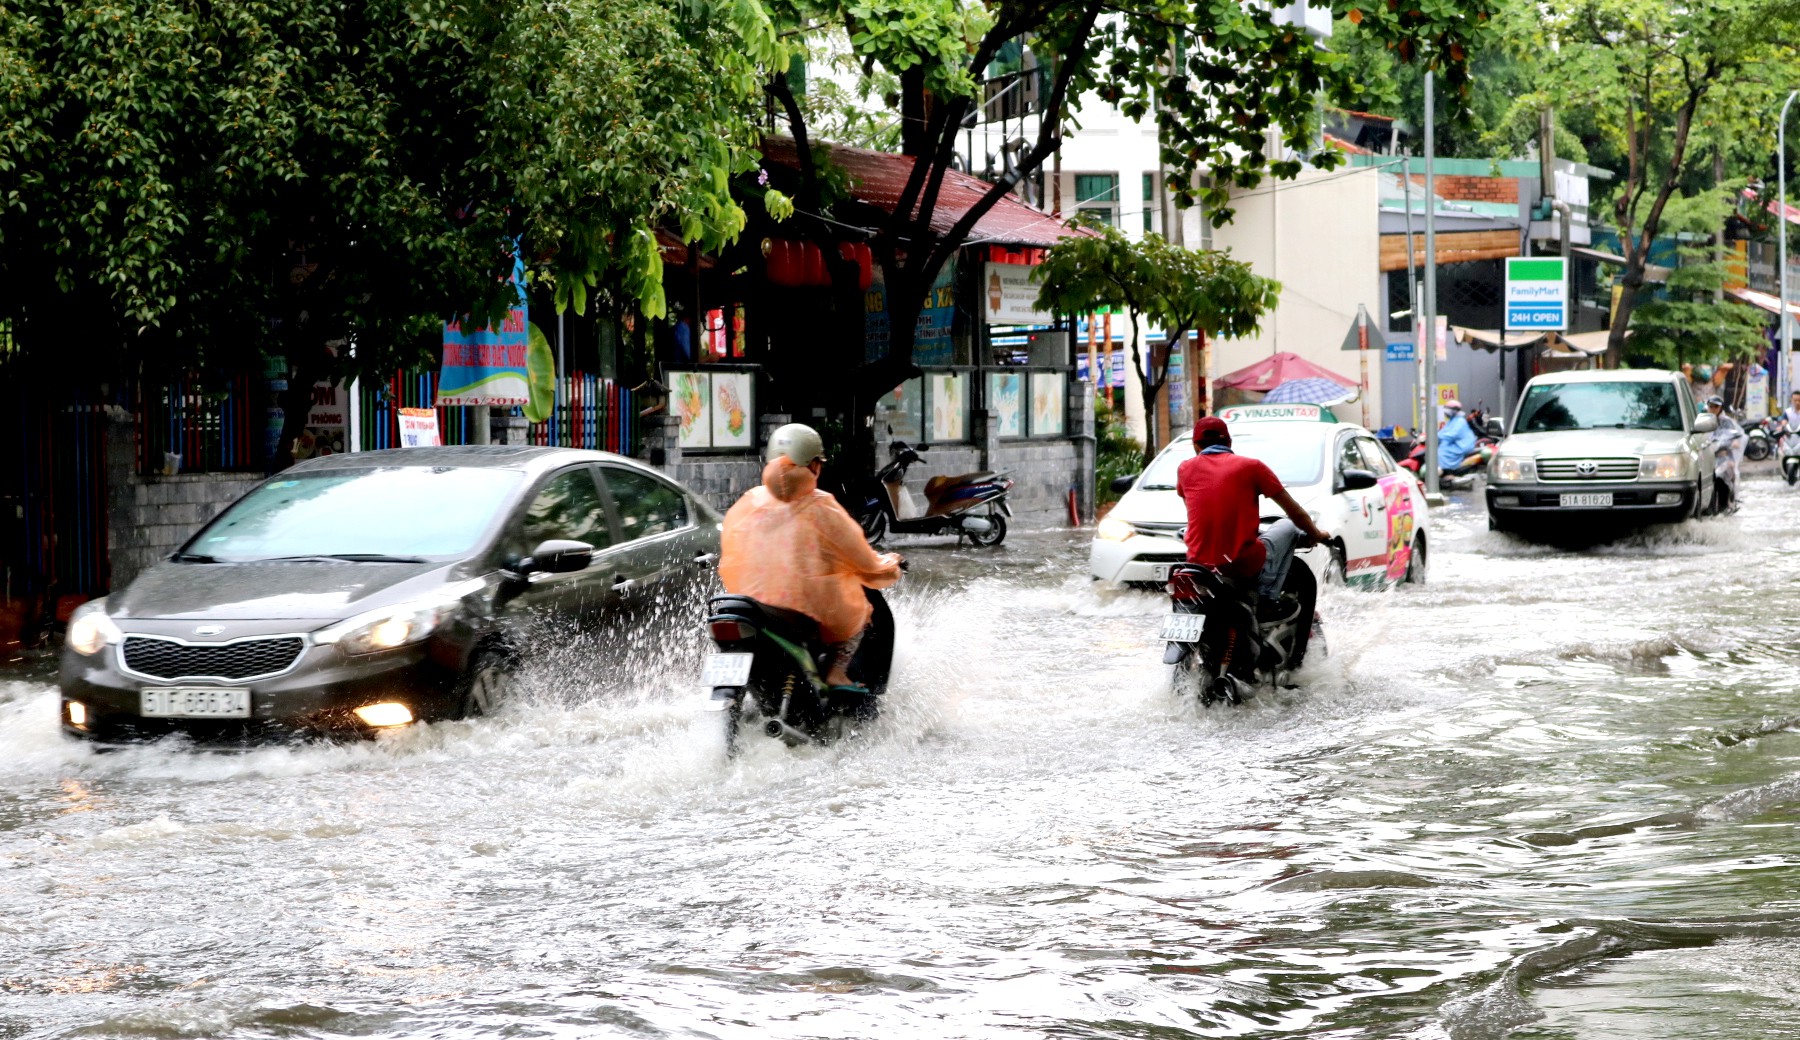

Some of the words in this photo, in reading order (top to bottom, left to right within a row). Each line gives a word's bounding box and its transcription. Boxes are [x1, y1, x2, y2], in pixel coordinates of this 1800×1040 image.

[1511, 287, 1559, 297] FamilyMart
[1511, 312, 1530, 322] 24H
[1532, 312, 1560, 323] OPEN
[442, 397, 528, 405] 01/4/2019
[1154, 566, 1167, 579] 51
[1160, 628, 1198, 640] 203.13
